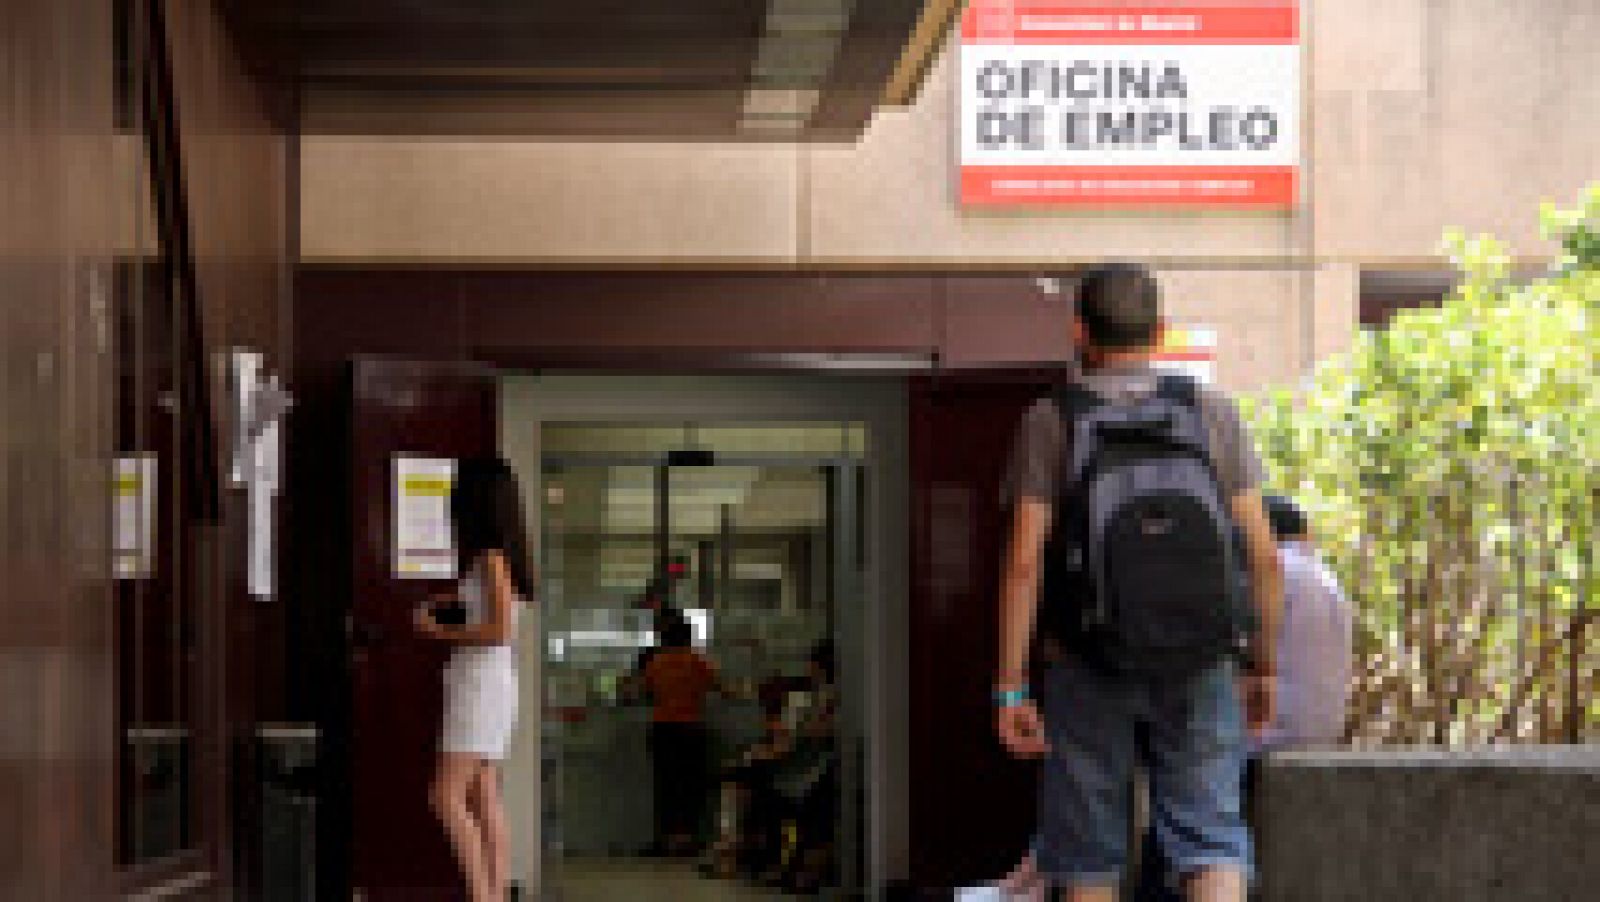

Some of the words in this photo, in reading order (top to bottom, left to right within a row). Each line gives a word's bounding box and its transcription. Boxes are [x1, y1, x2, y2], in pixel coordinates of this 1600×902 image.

[976, 60, 1187, 100] OFICINA
[976, 106, 1044, 149] DE
[1064, 106, 1278, 149] EMPLEO
